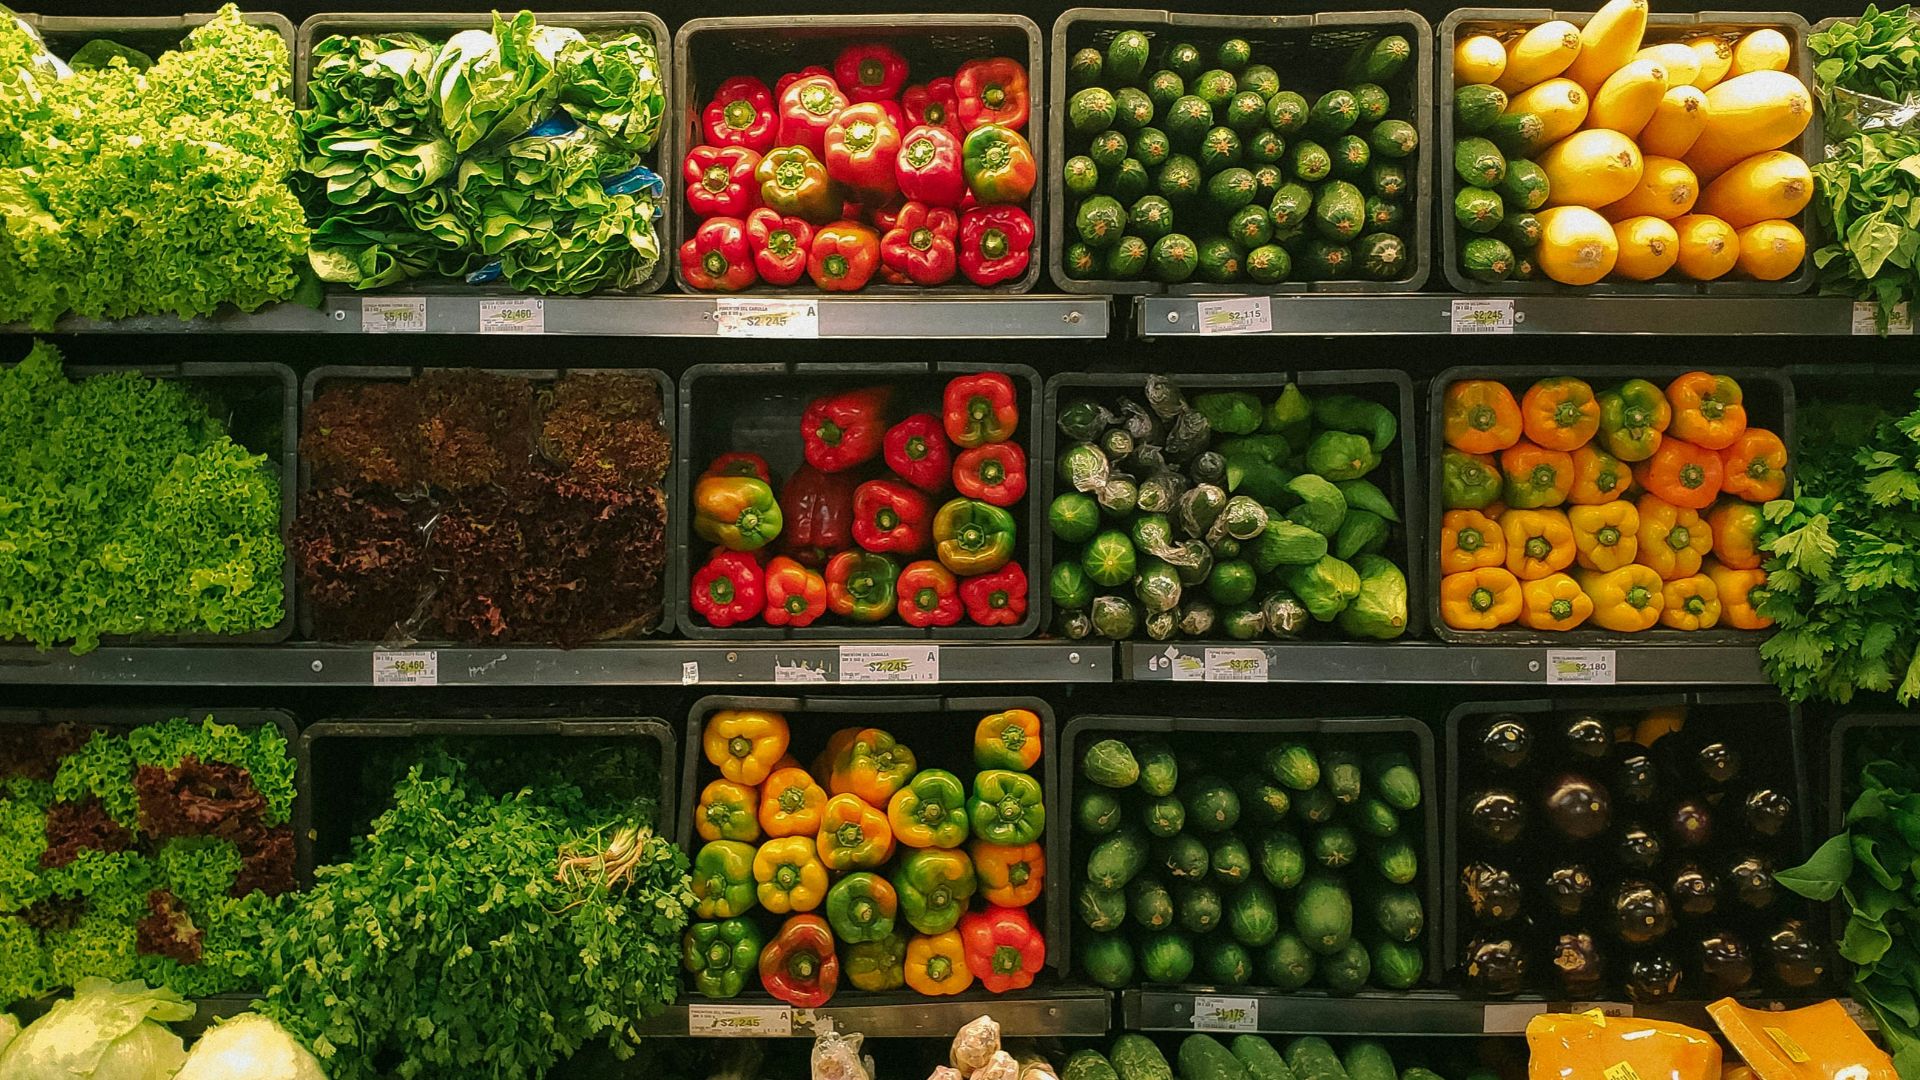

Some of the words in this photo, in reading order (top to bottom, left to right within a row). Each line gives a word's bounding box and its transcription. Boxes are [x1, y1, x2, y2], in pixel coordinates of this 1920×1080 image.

[807, 307, 816, 316] A
[1473, 310, 1503, 320] $2,245
[927, 652, 936, 661] A
[395, 660, 425, 670] $2,460
[869, 662, 908, 672] $2,245
[1250, 1001, 1256, 1009] A
[780, 1011, 788, 1019] A
[720, 1018, 760, 1027] $2,245
